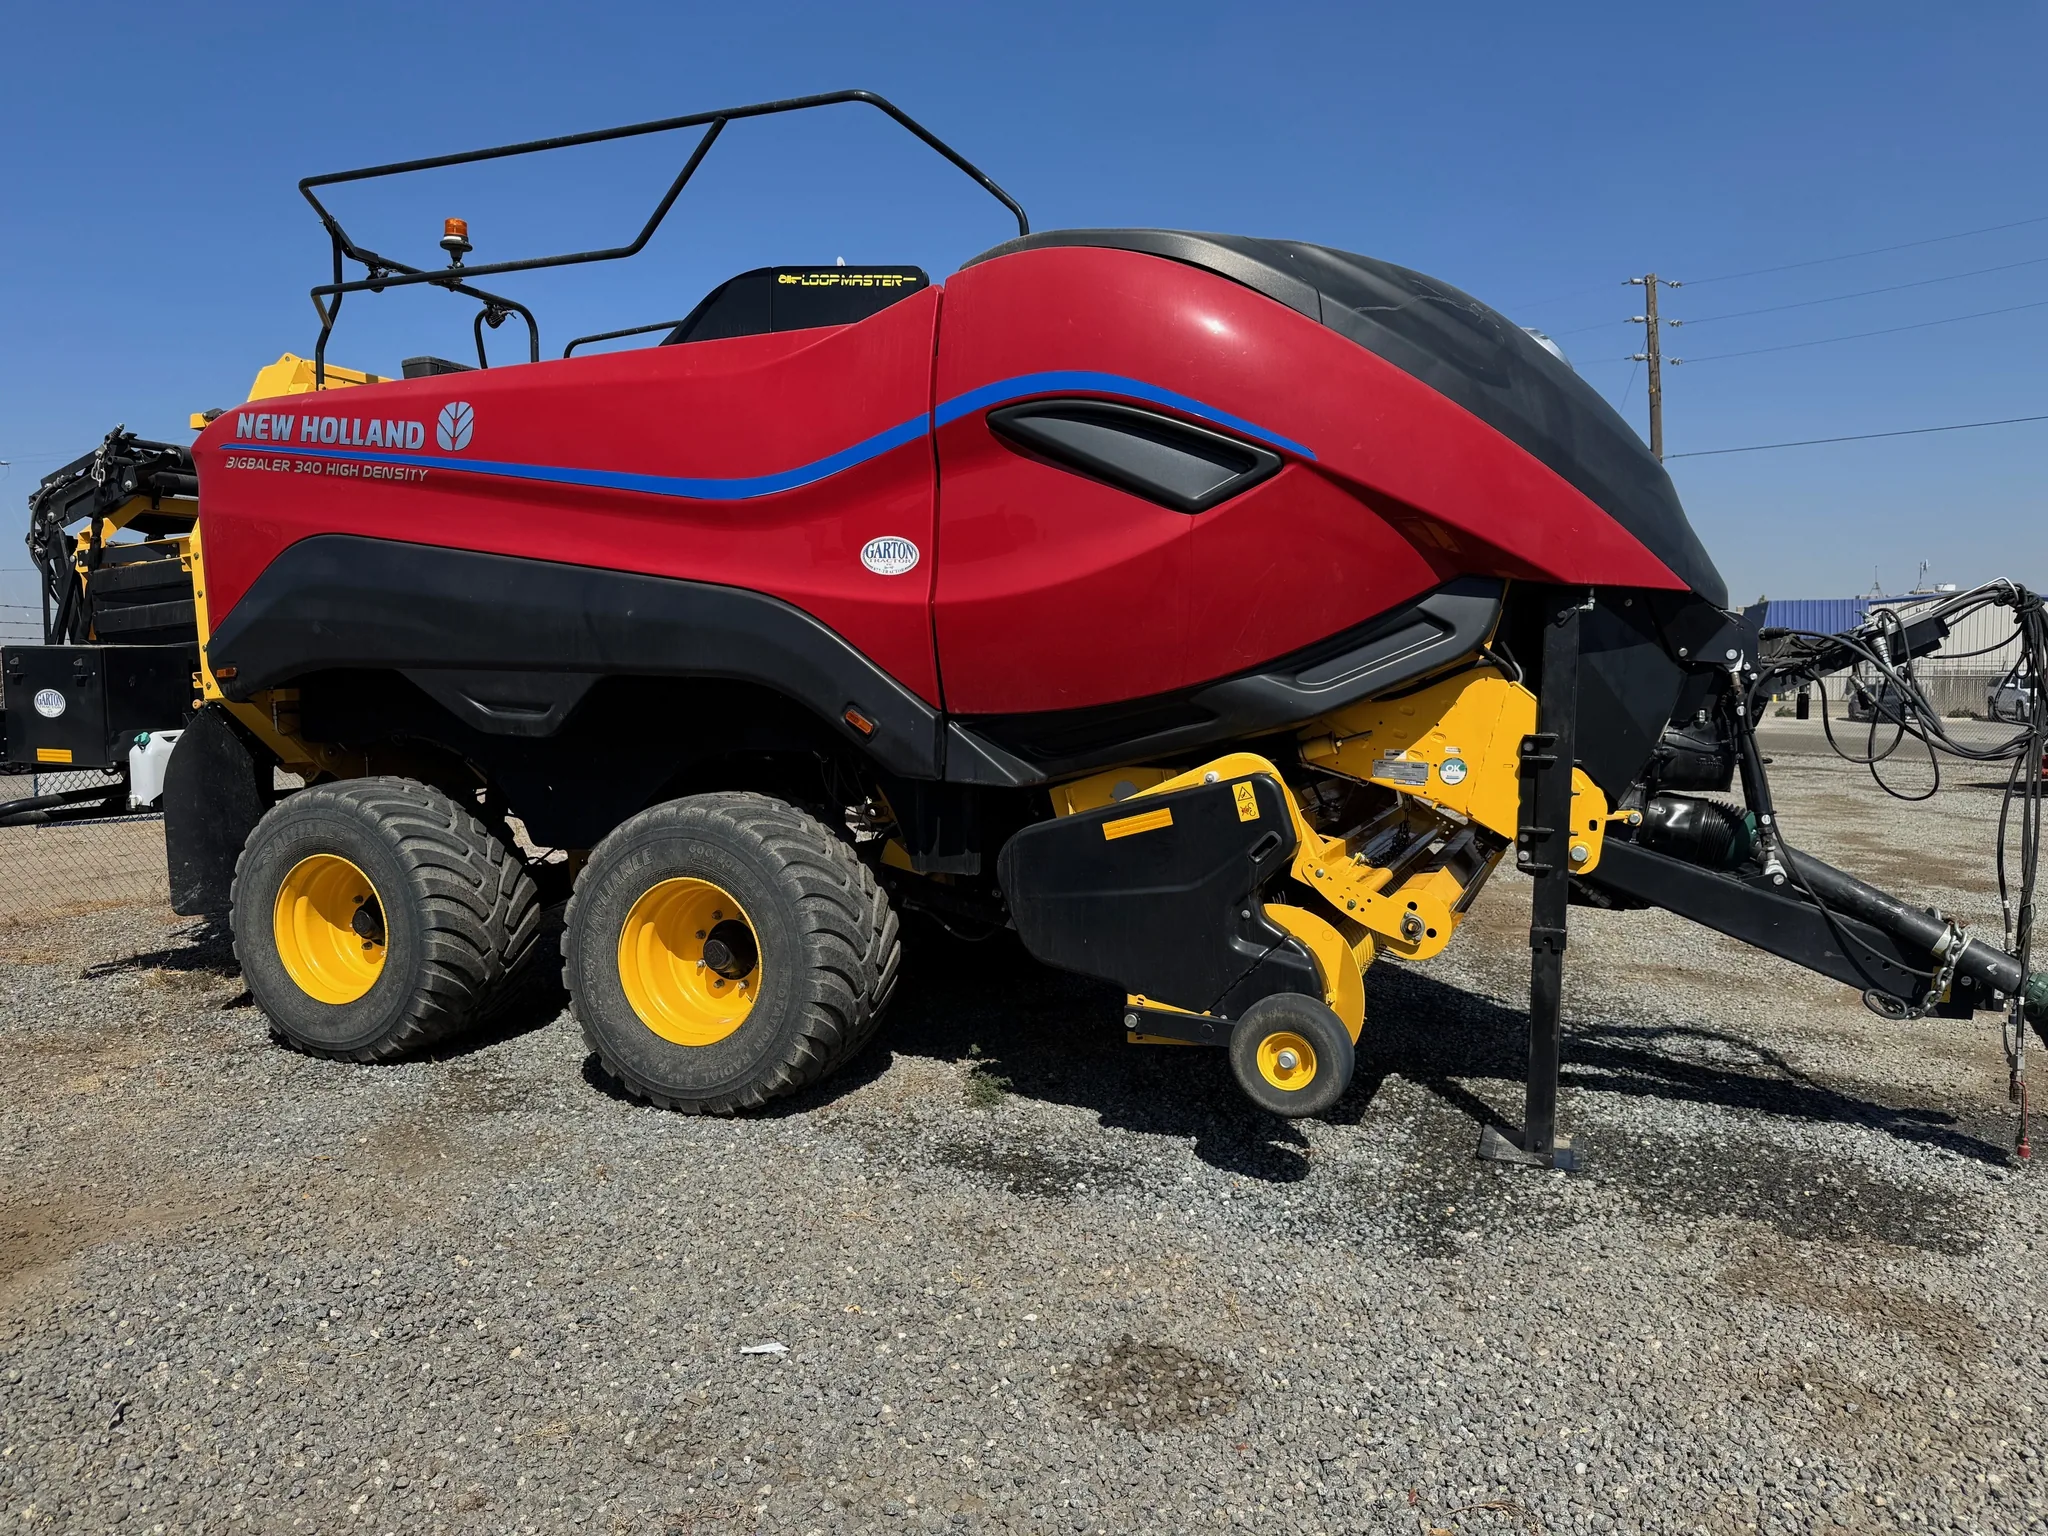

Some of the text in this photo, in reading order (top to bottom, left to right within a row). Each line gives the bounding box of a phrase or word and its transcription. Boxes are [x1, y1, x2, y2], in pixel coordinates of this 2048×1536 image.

[236, 412, 426, 450] NEW HOLLAND
[225, 456, 429, 482] BIGBALER 340 HIGH DENSITY
[865, 541, 914, 560] GARTON
[36, 692, 63, 707] GARTON
[1445, 764, 1462, 773] OK
[587, 846, 655, 935] ALLIANCE
[700, 1051, 752, 1084] RADIAL
